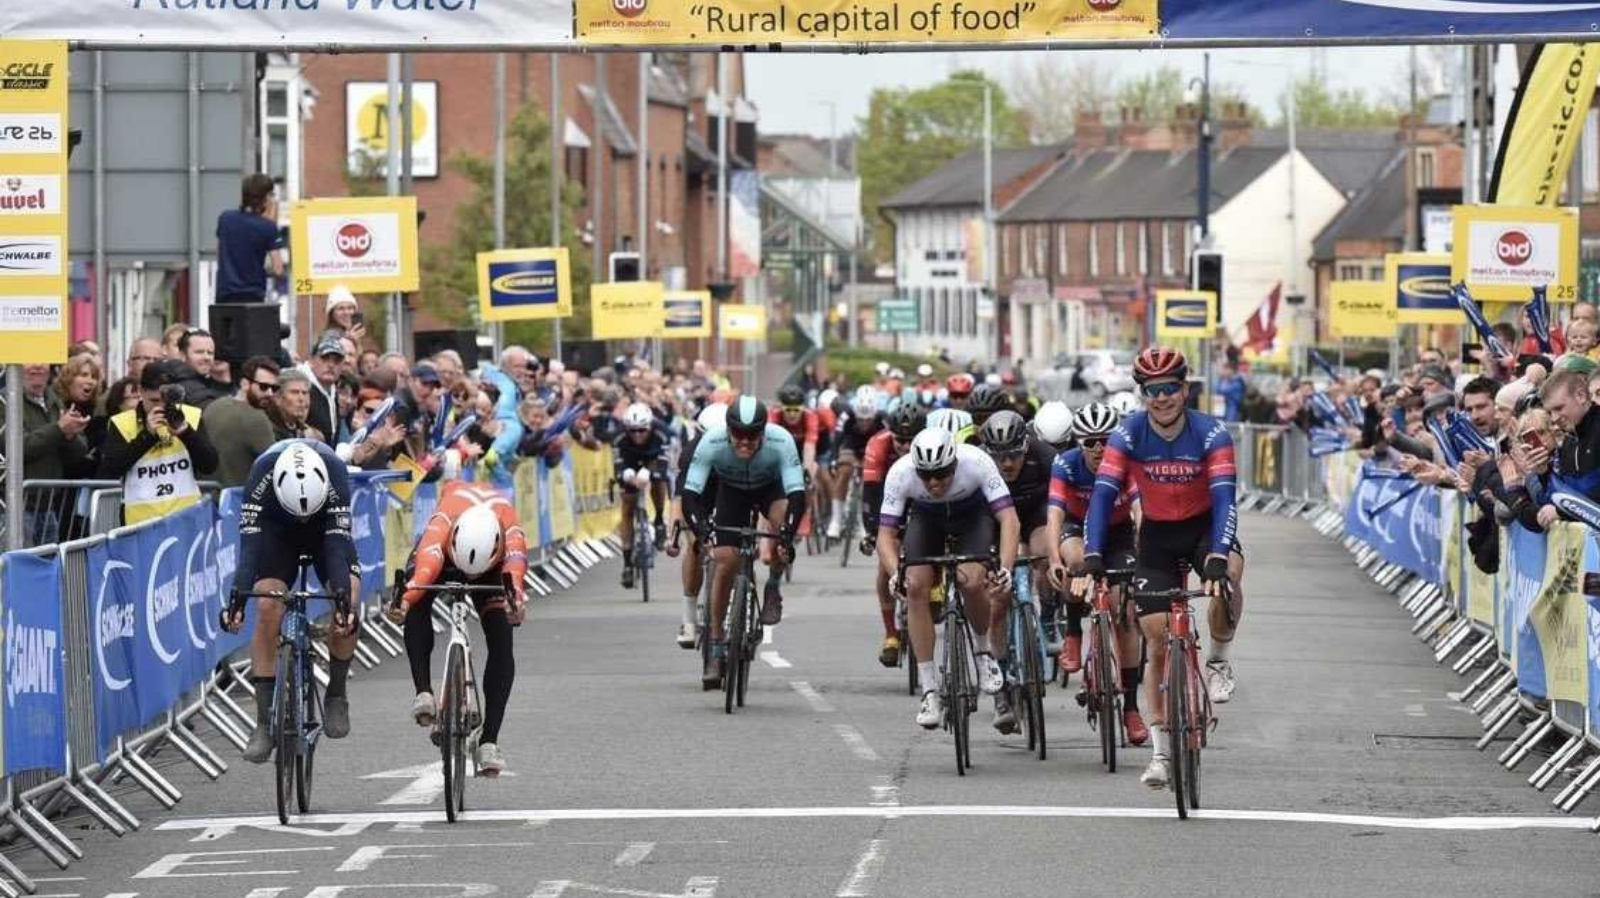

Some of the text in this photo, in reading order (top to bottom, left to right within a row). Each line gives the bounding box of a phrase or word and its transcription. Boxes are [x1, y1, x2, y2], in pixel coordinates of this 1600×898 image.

[797, 3, 898, 38] capital
[910, 3, 942, 31] of
[1498, 240, 1530, 258] bid
[296, 279, 313, 292] 25
[1557, 284, 1575, 299] 25
[137, 458, 190, 479] PHOTO
[156, 483, 175, 497] 29
[15, 623, 58, 695] GIANT
